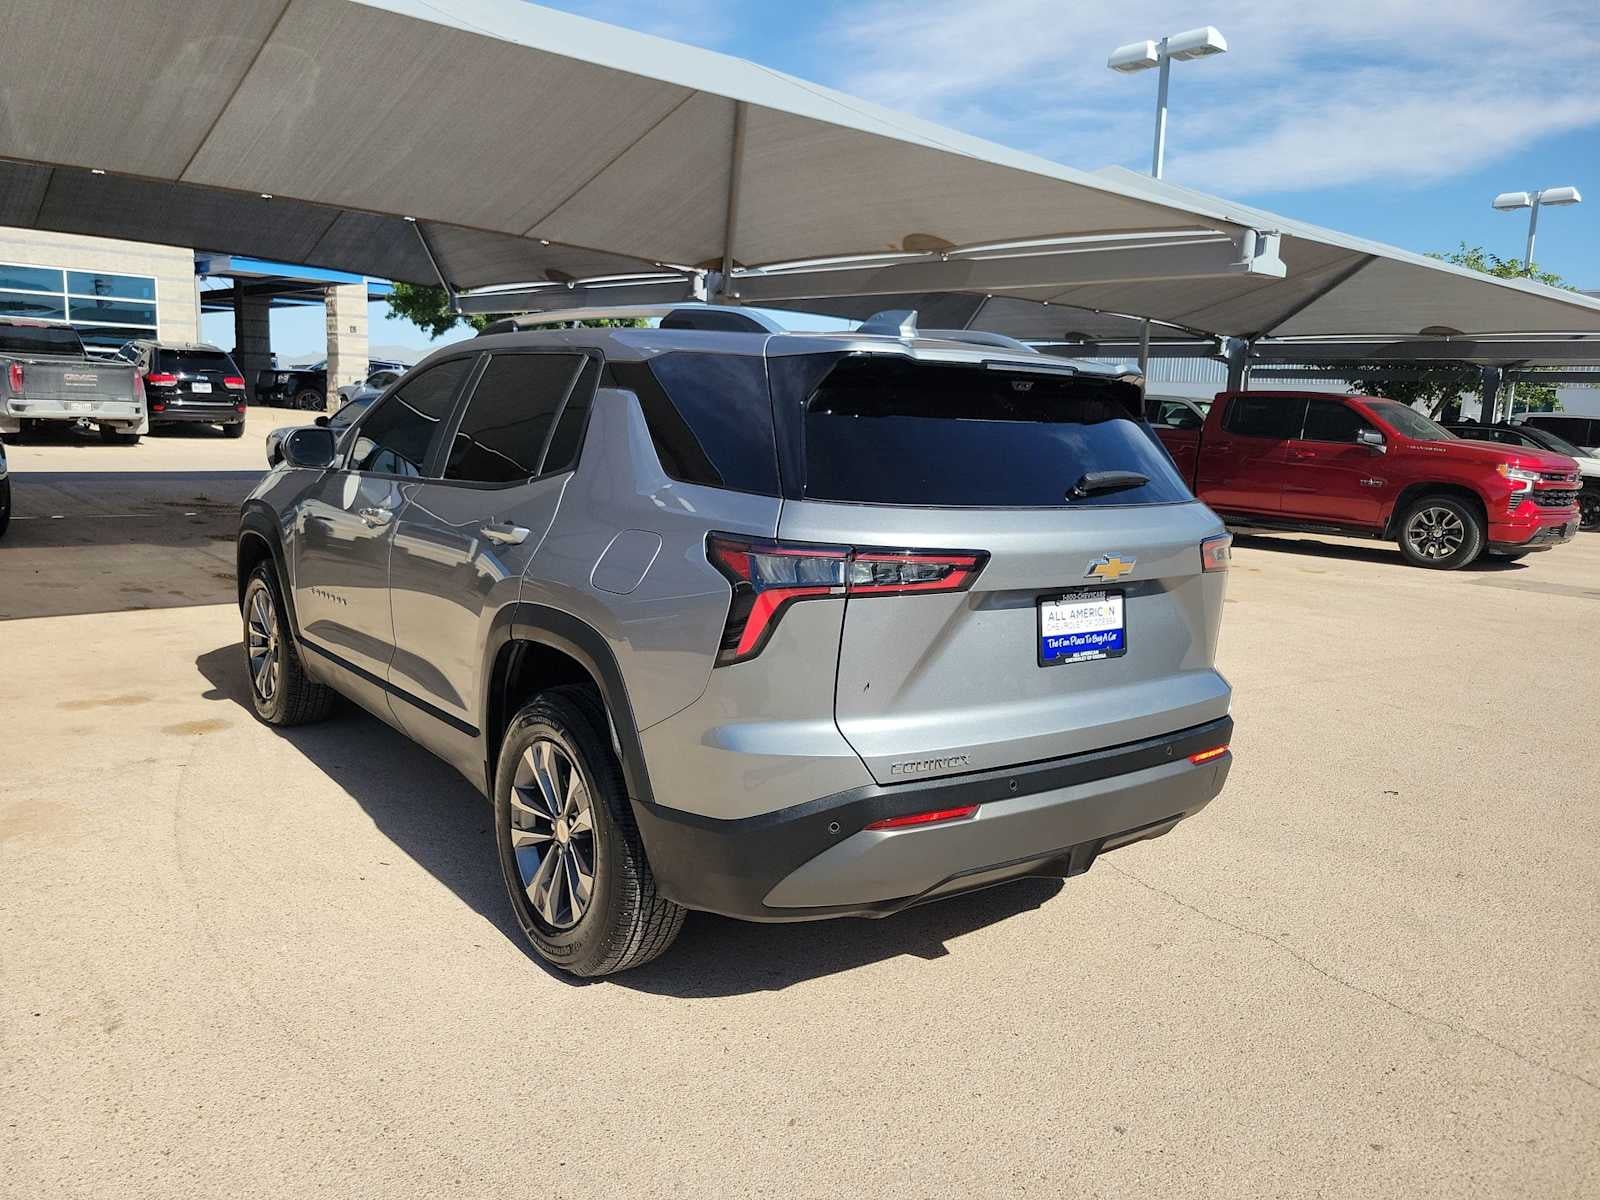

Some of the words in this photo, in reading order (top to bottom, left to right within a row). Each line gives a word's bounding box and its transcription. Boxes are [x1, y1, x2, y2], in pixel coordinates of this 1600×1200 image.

[1048, 611, 1066, 621] ALL
[1070, 606, 1115, 619] AMERICN
[890, 754, 969, 775] EQUINOX
